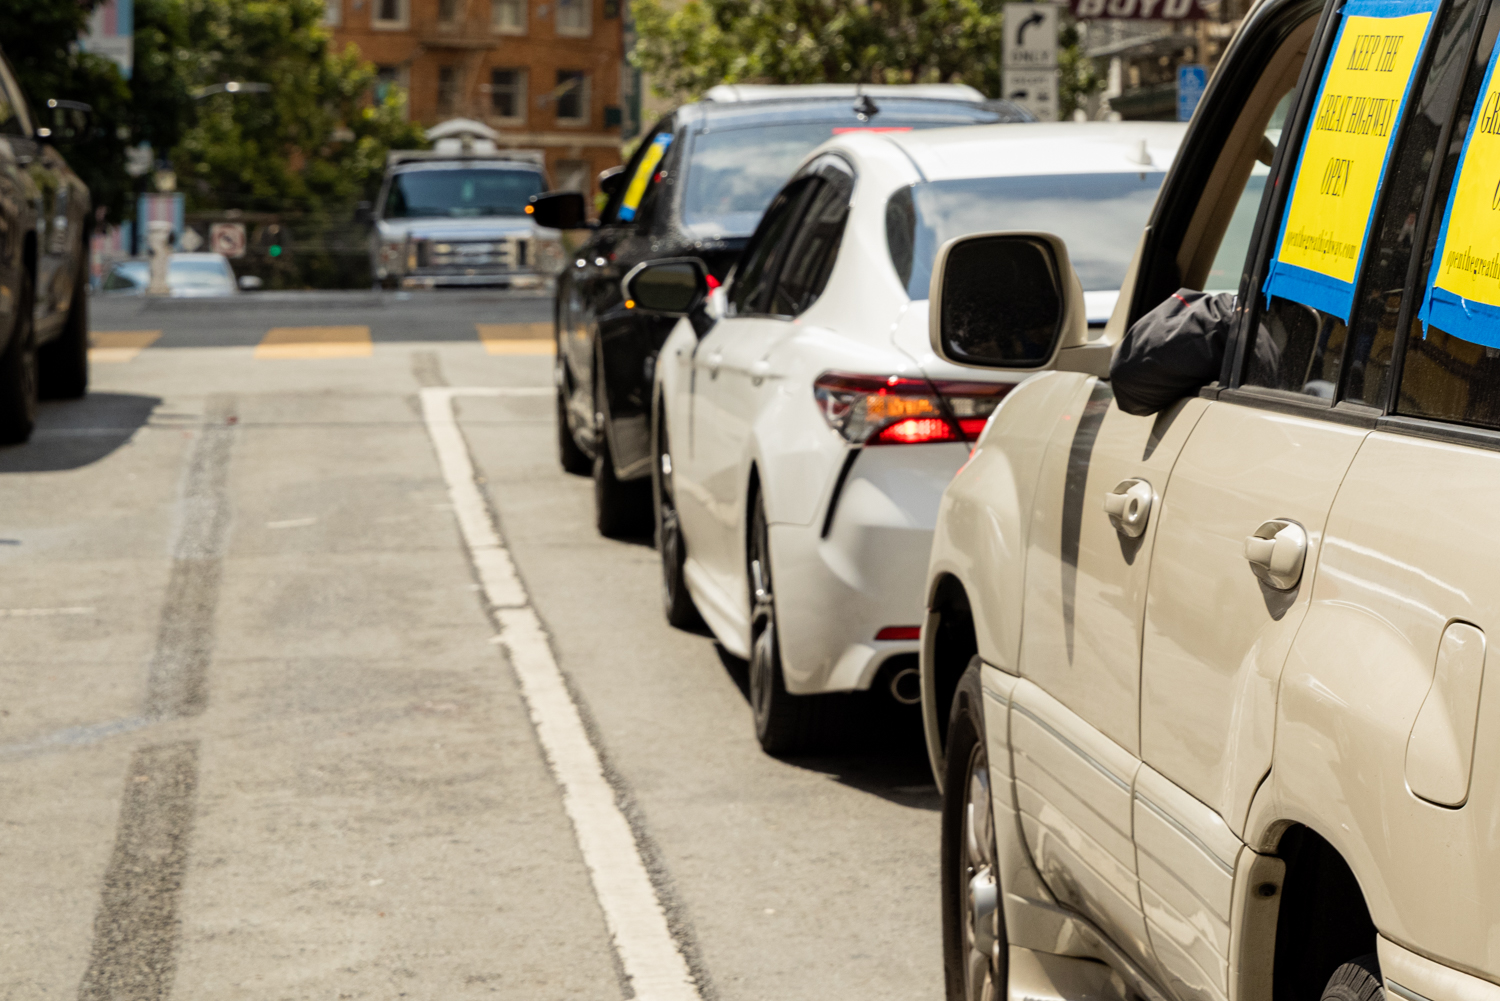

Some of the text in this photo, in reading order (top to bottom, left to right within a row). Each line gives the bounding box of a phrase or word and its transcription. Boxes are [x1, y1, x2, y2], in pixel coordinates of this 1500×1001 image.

[1346, 34, 1404, 72] KEEP THE
[1316, 94, 1399, 137] GREAT HIGHWAY
[1320, 156, 1354, 198] OPEN
